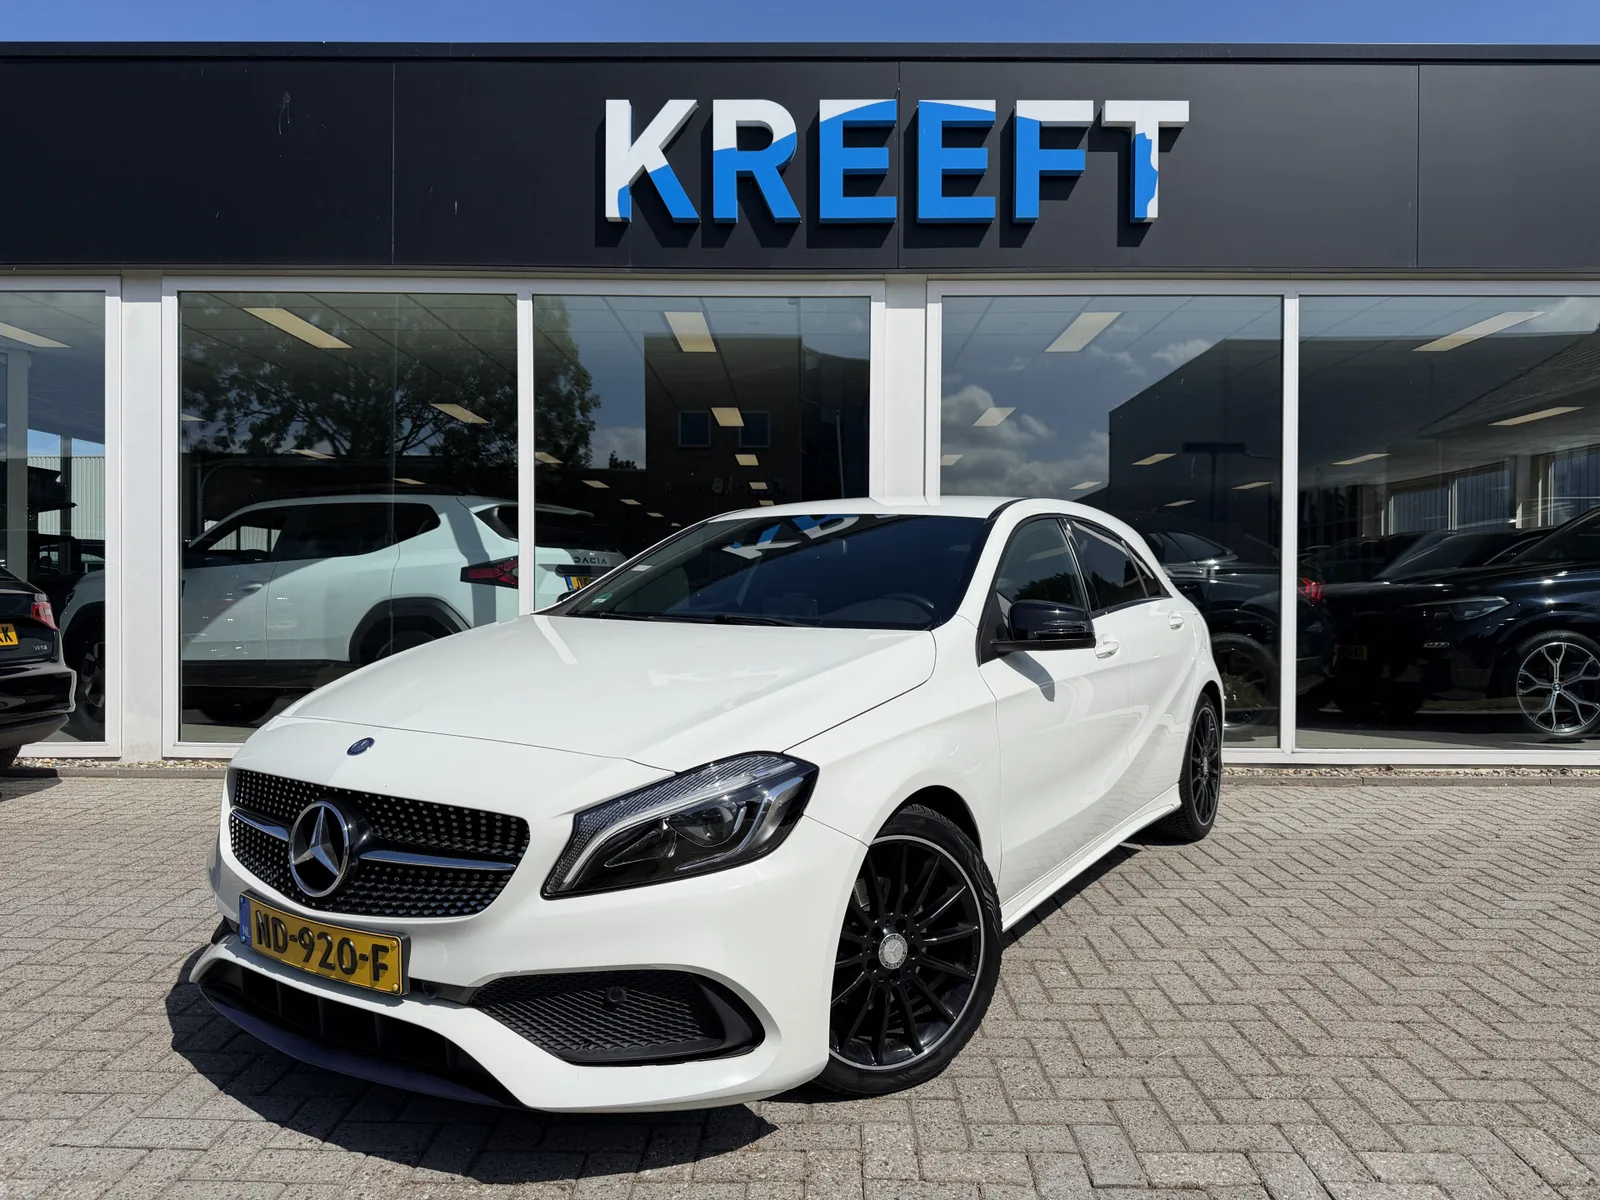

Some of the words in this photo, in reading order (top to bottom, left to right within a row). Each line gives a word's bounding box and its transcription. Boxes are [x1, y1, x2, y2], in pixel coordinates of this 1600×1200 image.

[605, 99, 1189, 222] KREEFT
[573, 556, 607, 564] DACIA
[255, 909, 390, 981] ND-920-F
